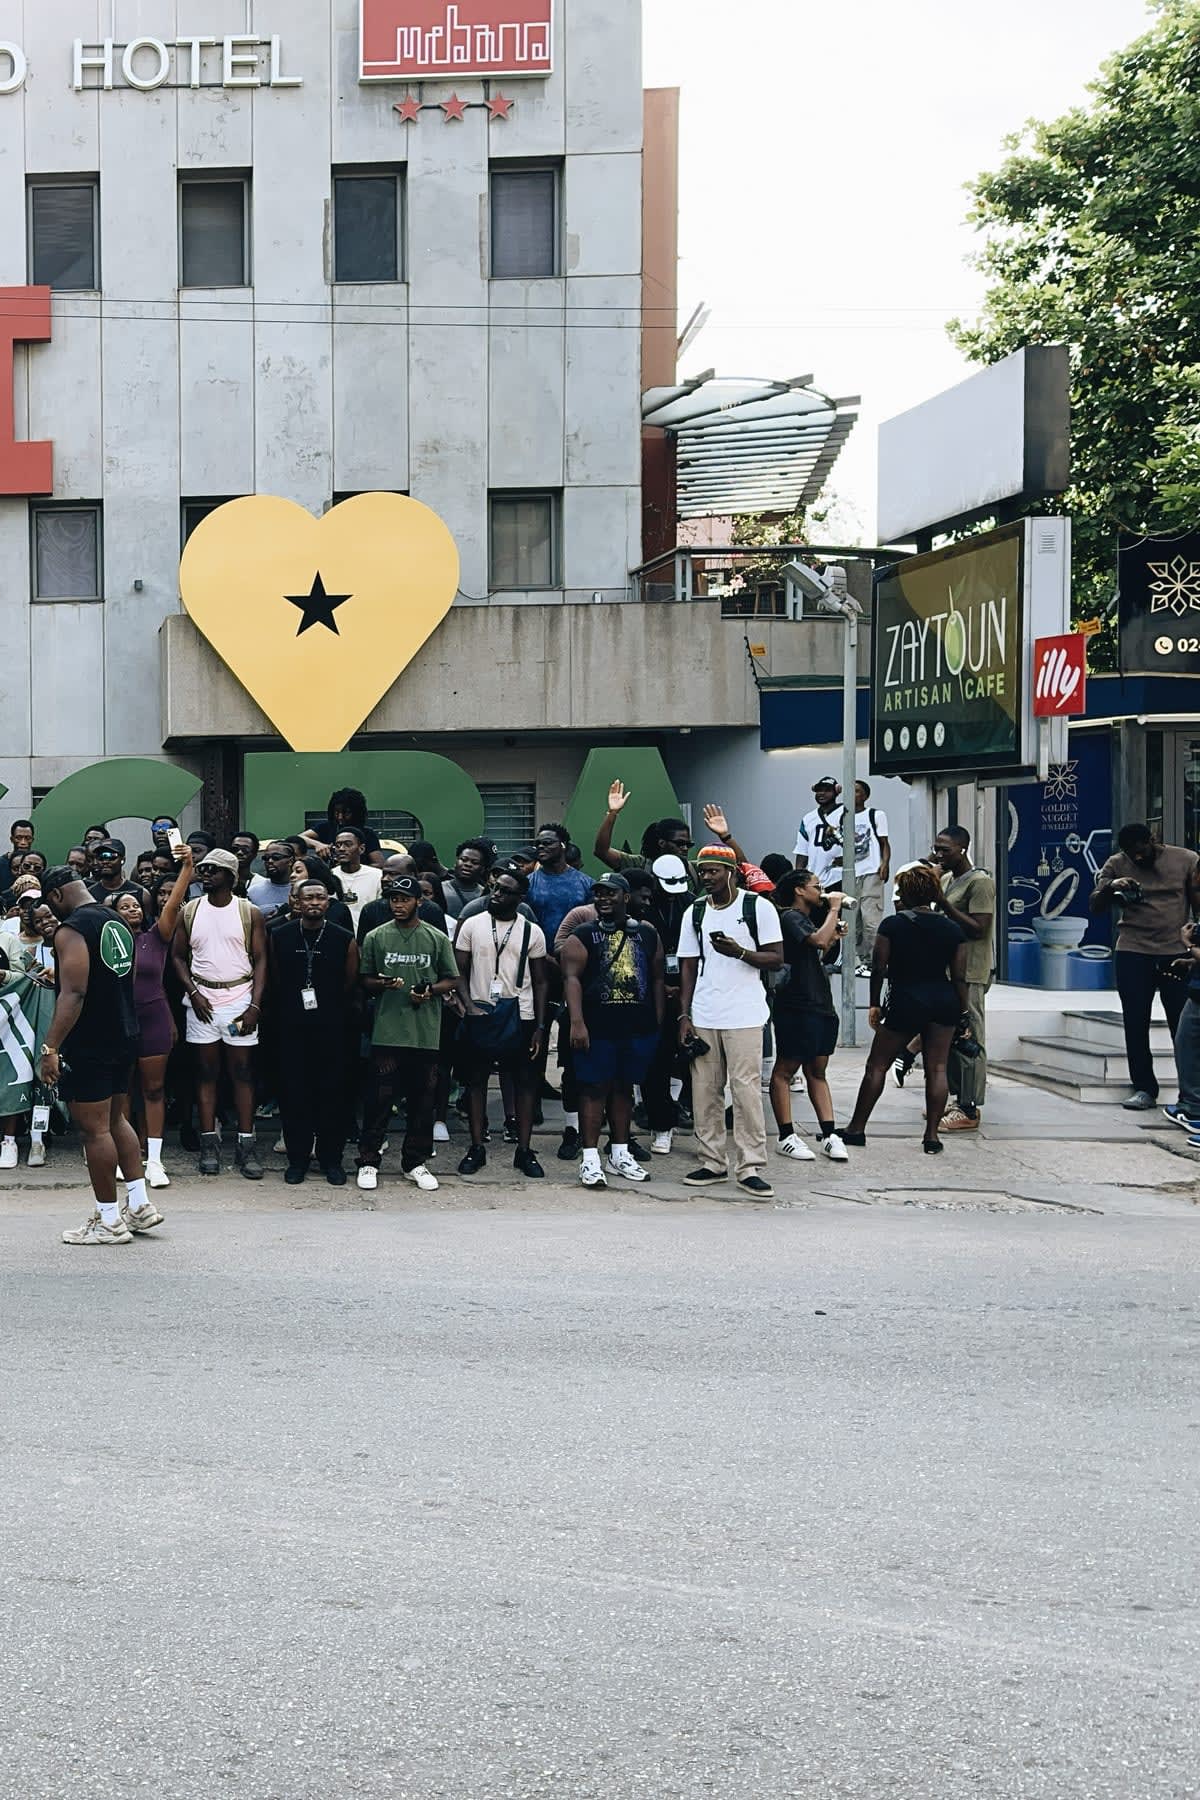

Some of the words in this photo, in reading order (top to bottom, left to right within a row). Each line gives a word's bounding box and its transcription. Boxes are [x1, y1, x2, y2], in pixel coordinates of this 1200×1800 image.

[73, 34, 303, 91] HOTEL
[884, 597, 1007, 688] ZAYTOUN
[1177, 638, 1200, 653] 02
[884, 682, 952, 713] ARTISAN
[964, 672, 1006, 700] CAFE
[1036, 647, 1081, 709] illy
[1041, 803, 1078, 812] GOLDEN
[1041, 813, 1078, 822] NUGGET
